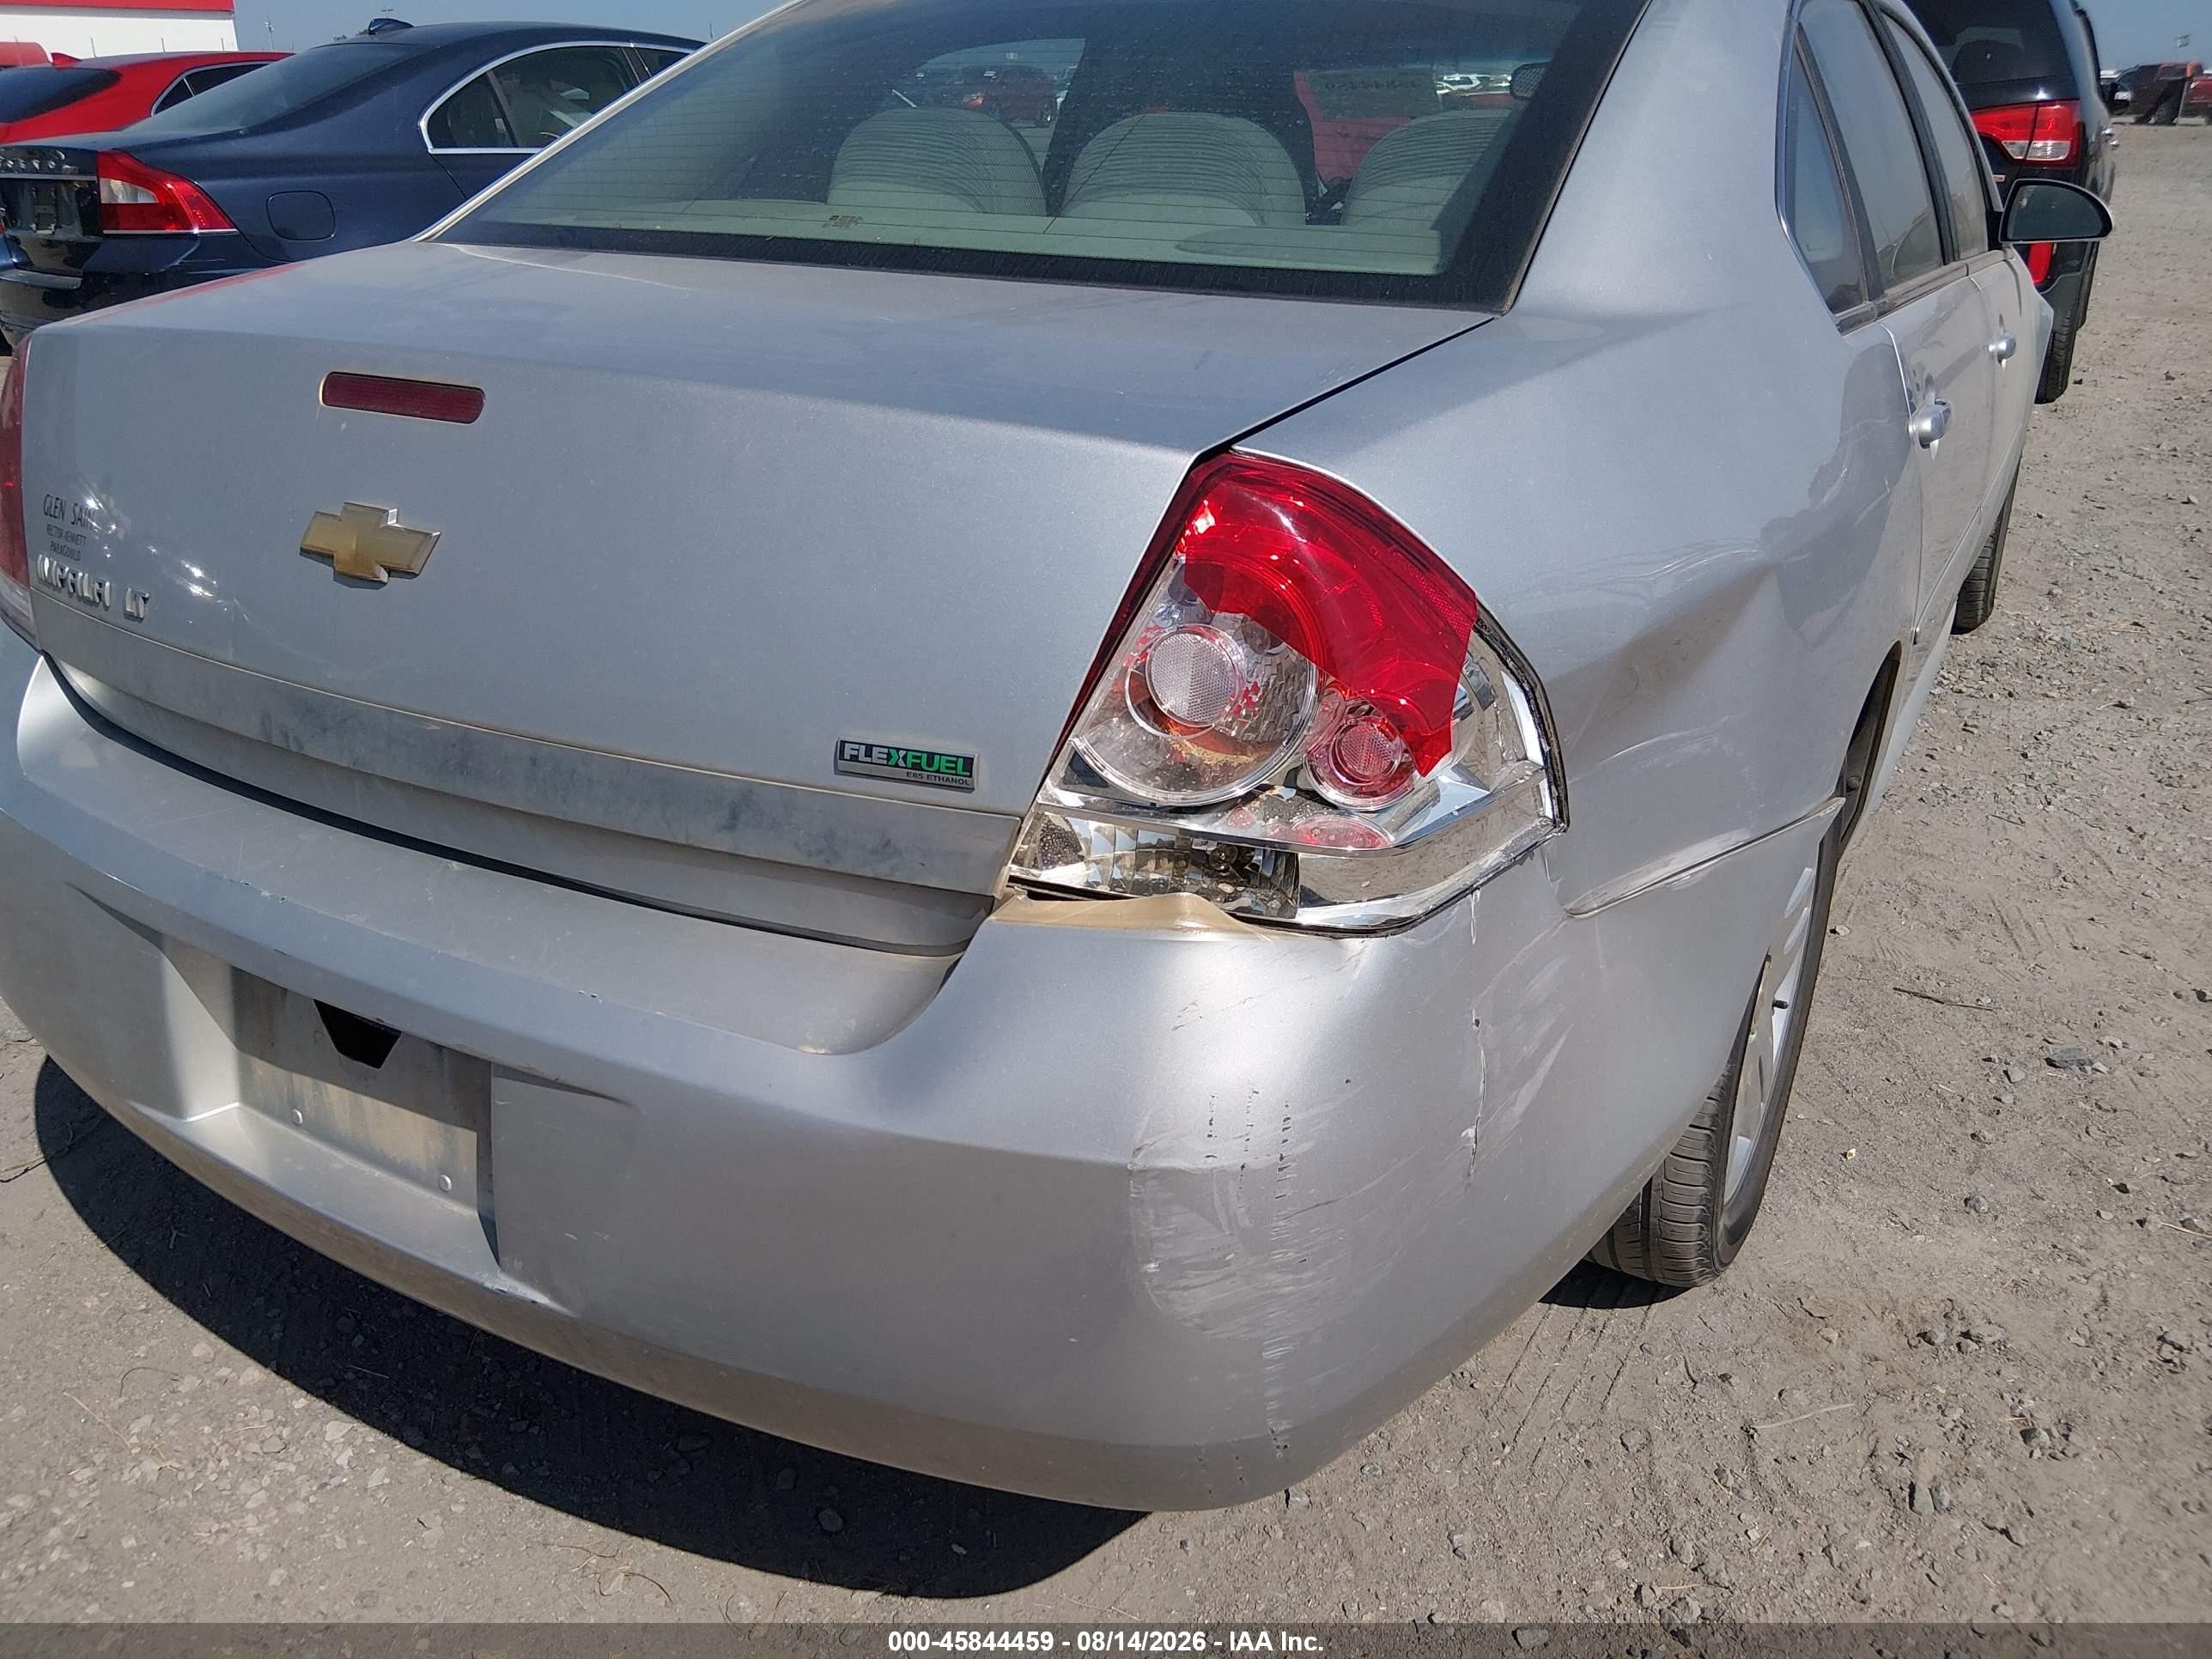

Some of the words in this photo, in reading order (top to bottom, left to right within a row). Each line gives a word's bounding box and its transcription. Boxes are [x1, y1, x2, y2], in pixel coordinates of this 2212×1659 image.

[43, 494, 68, 521] GLEN
[37, 554, 111, 606] IMPALA
[125, 587, 151, 618] LT
[843, 742, 971, 776] FLEXFUEL
[906, 771, 924, 780] E85
[927, 774, 970, 786] ETHANOL
